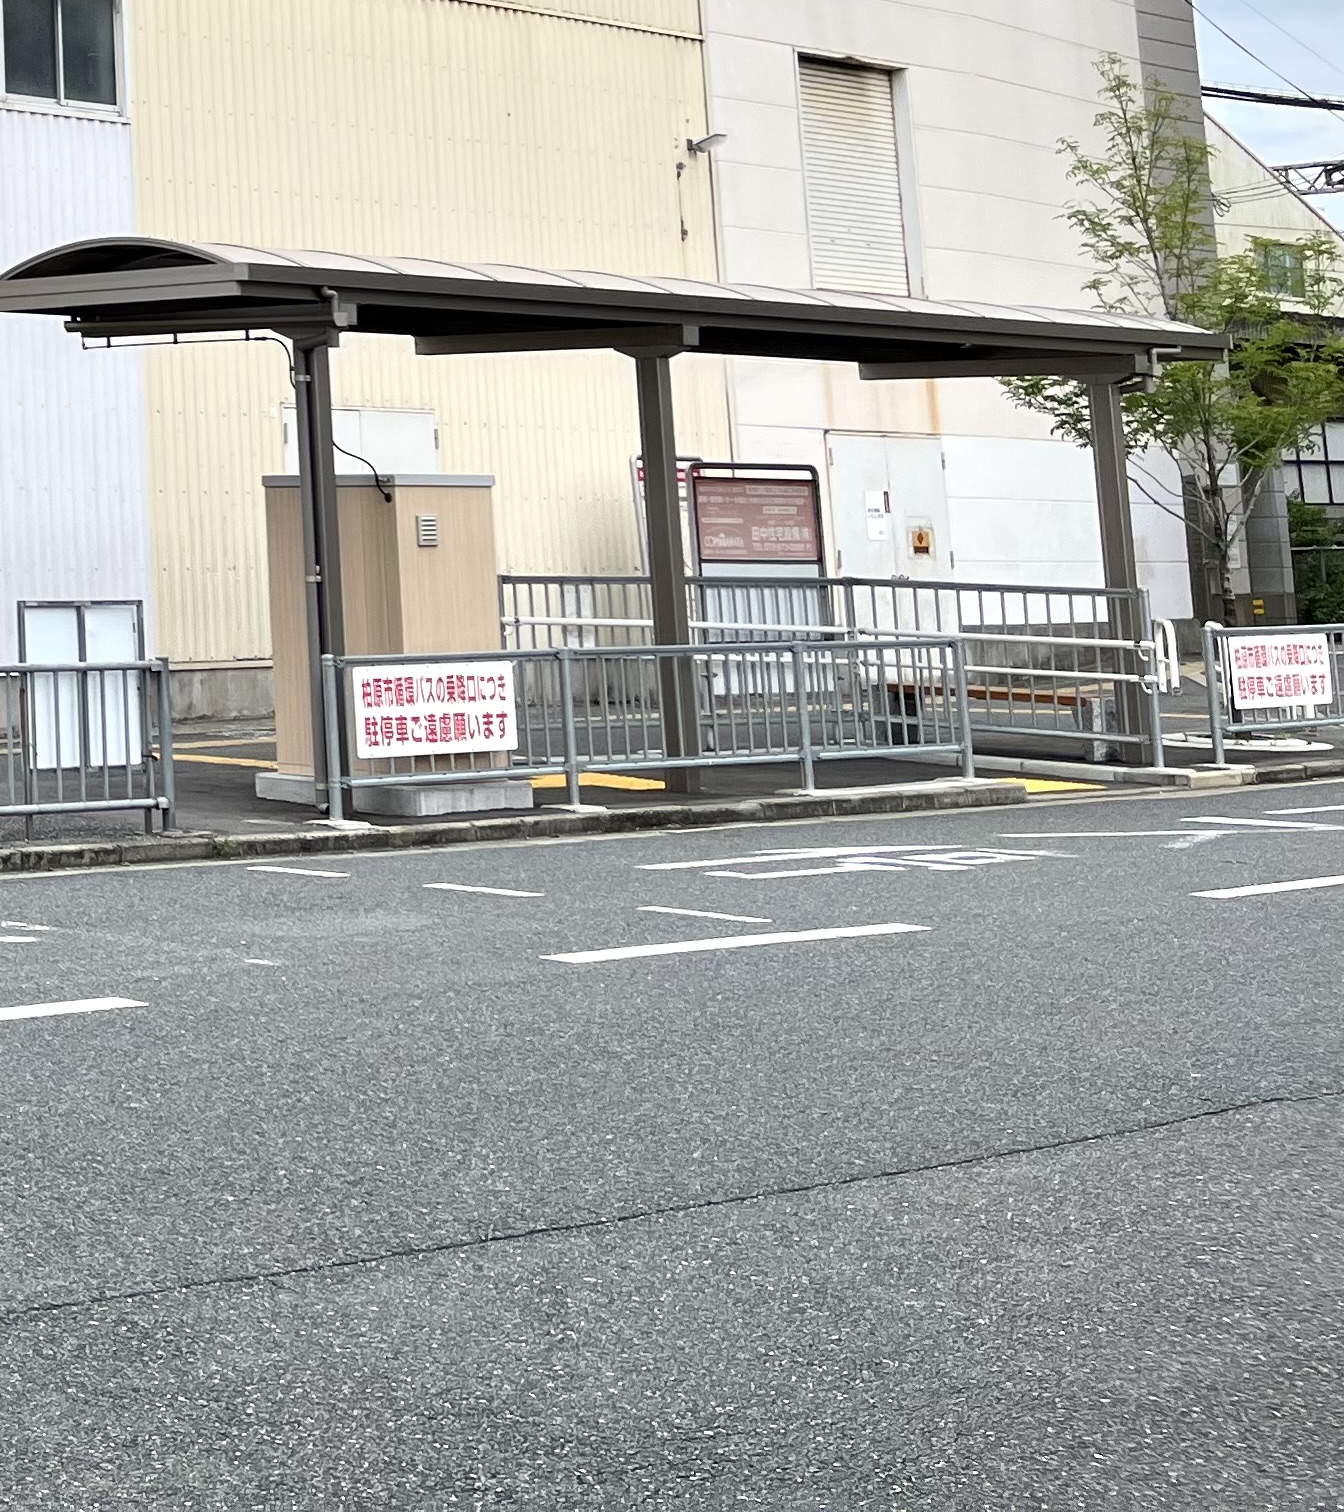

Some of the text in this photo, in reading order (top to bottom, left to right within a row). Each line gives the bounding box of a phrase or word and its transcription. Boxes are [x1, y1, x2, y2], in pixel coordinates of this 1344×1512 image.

[365, 711, 509, 747] 駐停車ご遠慮願います
